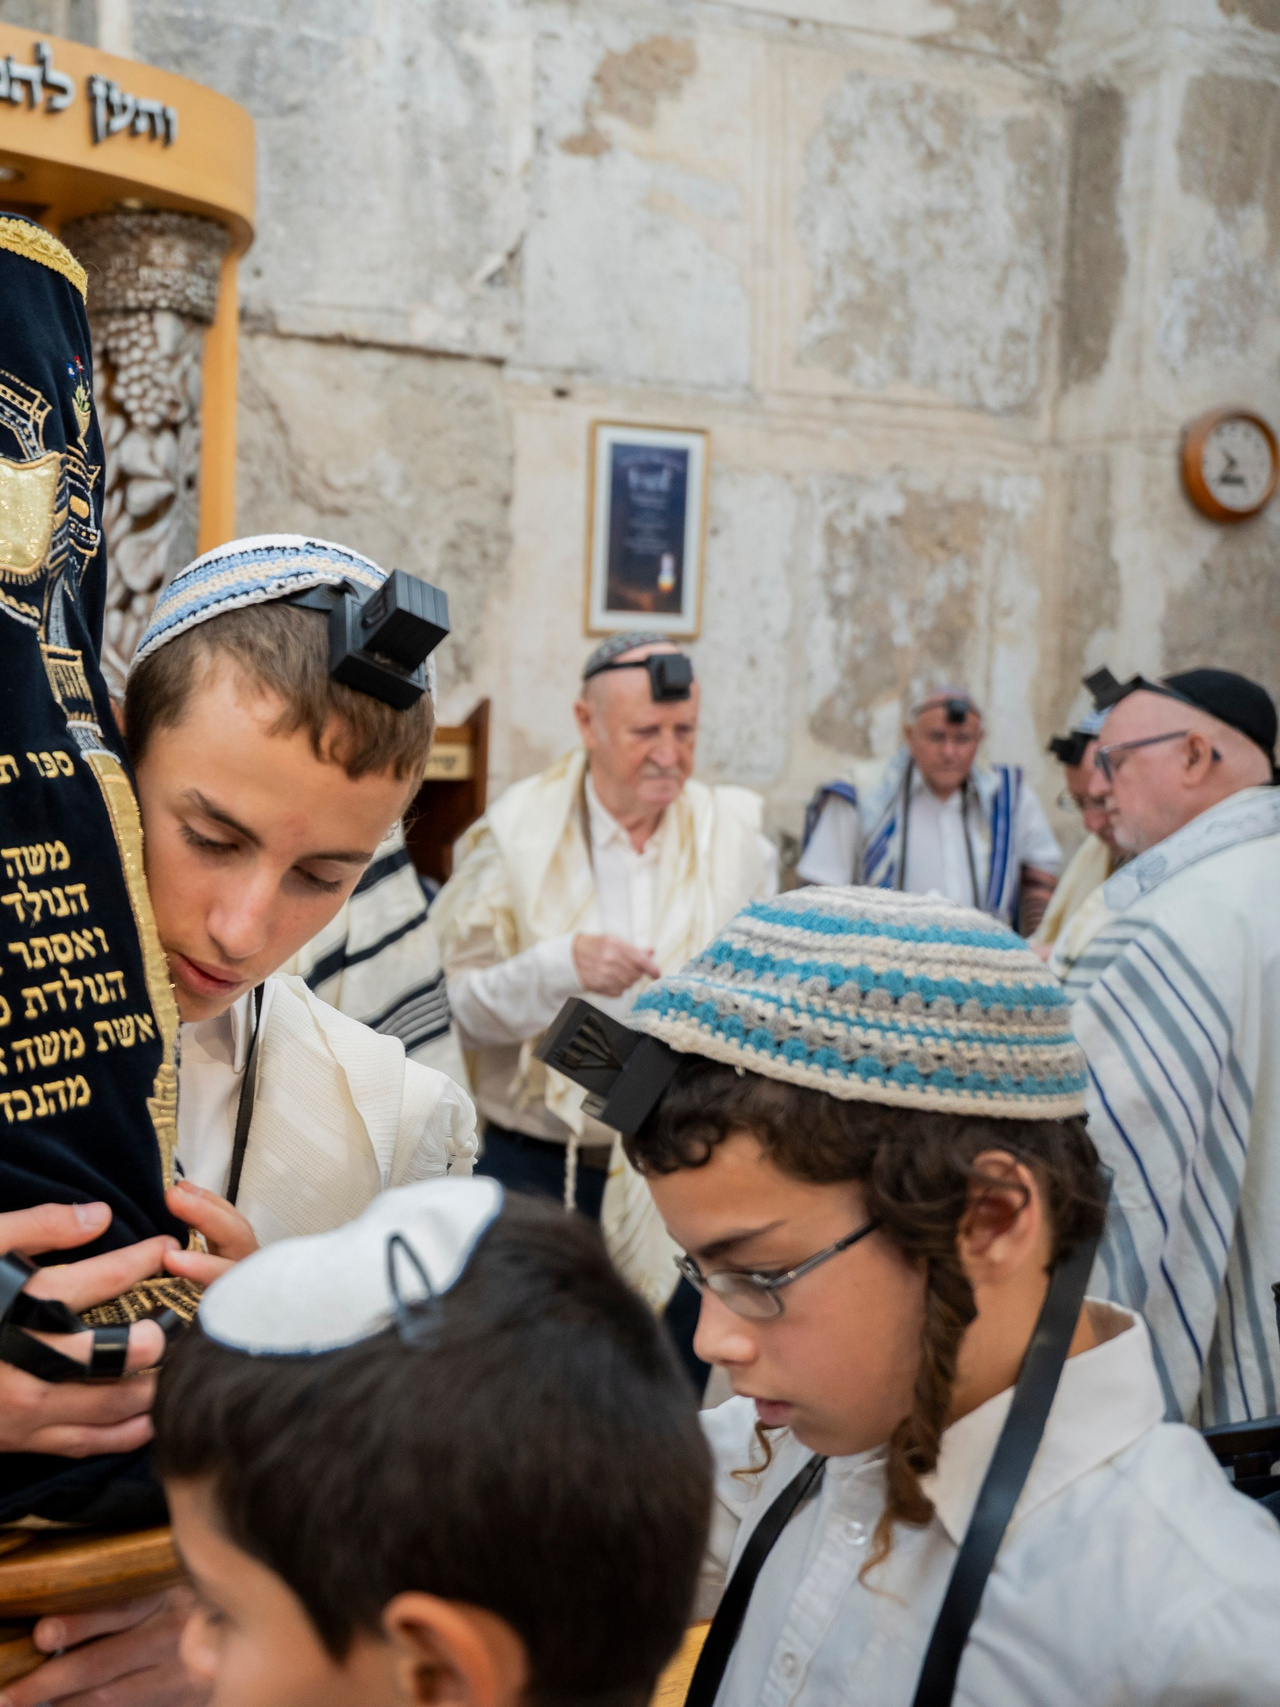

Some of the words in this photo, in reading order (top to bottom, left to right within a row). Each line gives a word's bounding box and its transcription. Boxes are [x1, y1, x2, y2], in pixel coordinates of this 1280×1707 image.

[88, 74, 178, 146] ותען
[1, 840, 71, 877] משה
[1, 880, 89, 922] הנולד
[8, 927, 110, 970] ואסתר
[21, 968, 127, 1018] הנולדת
[11, 1027, 85, 1072] משה
[94, 1013, 156, 1052] אשת
